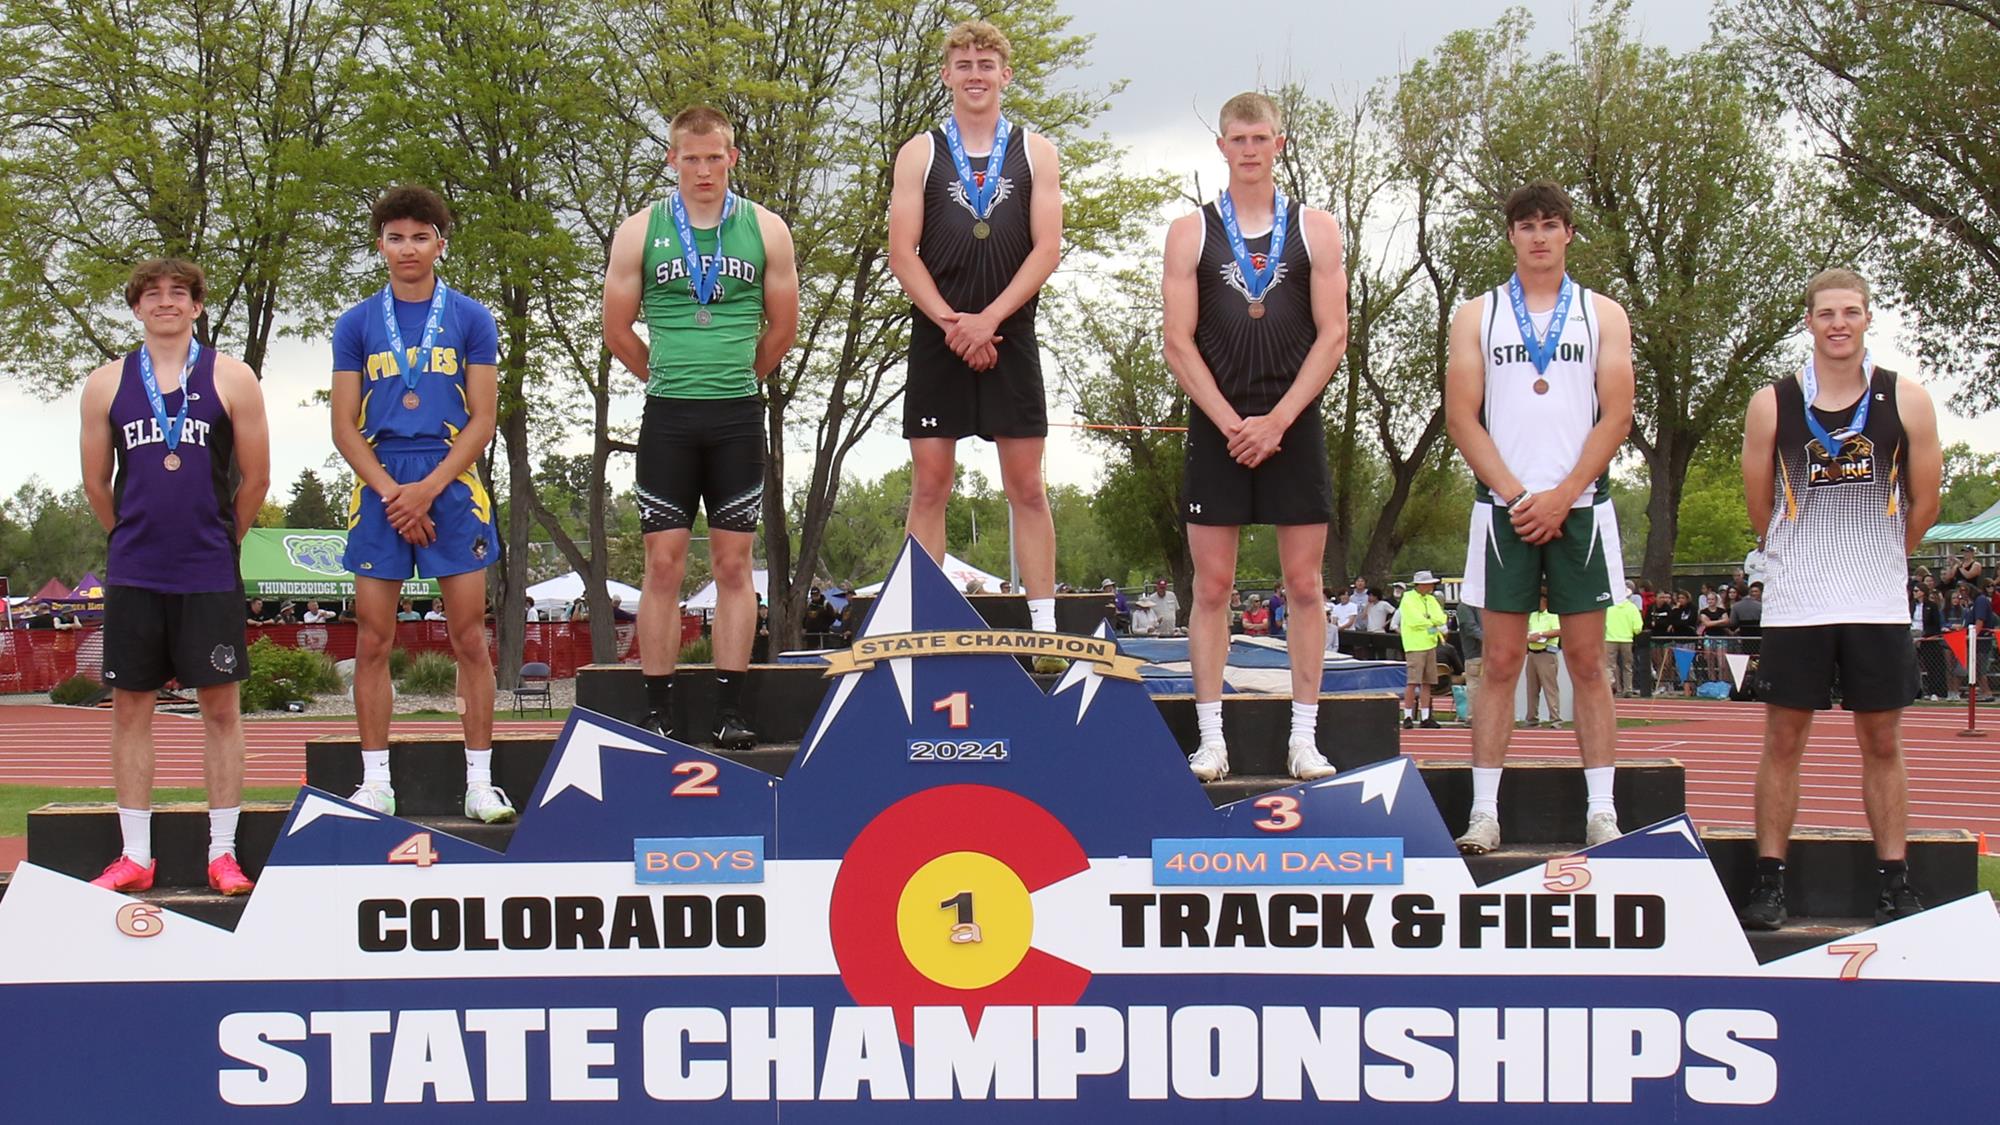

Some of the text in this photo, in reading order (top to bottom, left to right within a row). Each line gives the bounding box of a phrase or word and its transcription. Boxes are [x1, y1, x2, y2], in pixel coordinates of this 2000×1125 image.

[257, 582, 337, 595] THUNDERRIDGE
[861, 634, 1105, 656] STATE CHAMPION
[933, 691, 971, 728] 1
[910, 741, 1008, 761] 2024
[671, 759, 720, 797] 2
[1253, 795, 1303, 833] 3
[387, 832, 440, 867] 4
[646, 850, 755, 872] BOYS
[1165, 851, 1394, 873] 400M DASH
[1543, 855, 1593, 892] 5
[116, 902, 164, 938] 6
[358, 894, 766, 953] COLORADO
[1110, 892, 1666, 949] TRACK & FIELD
[1827, 943, 1878, 981] 7
[218, 1004, 1779, 1106] STATE CHAMPIONSHIPS
